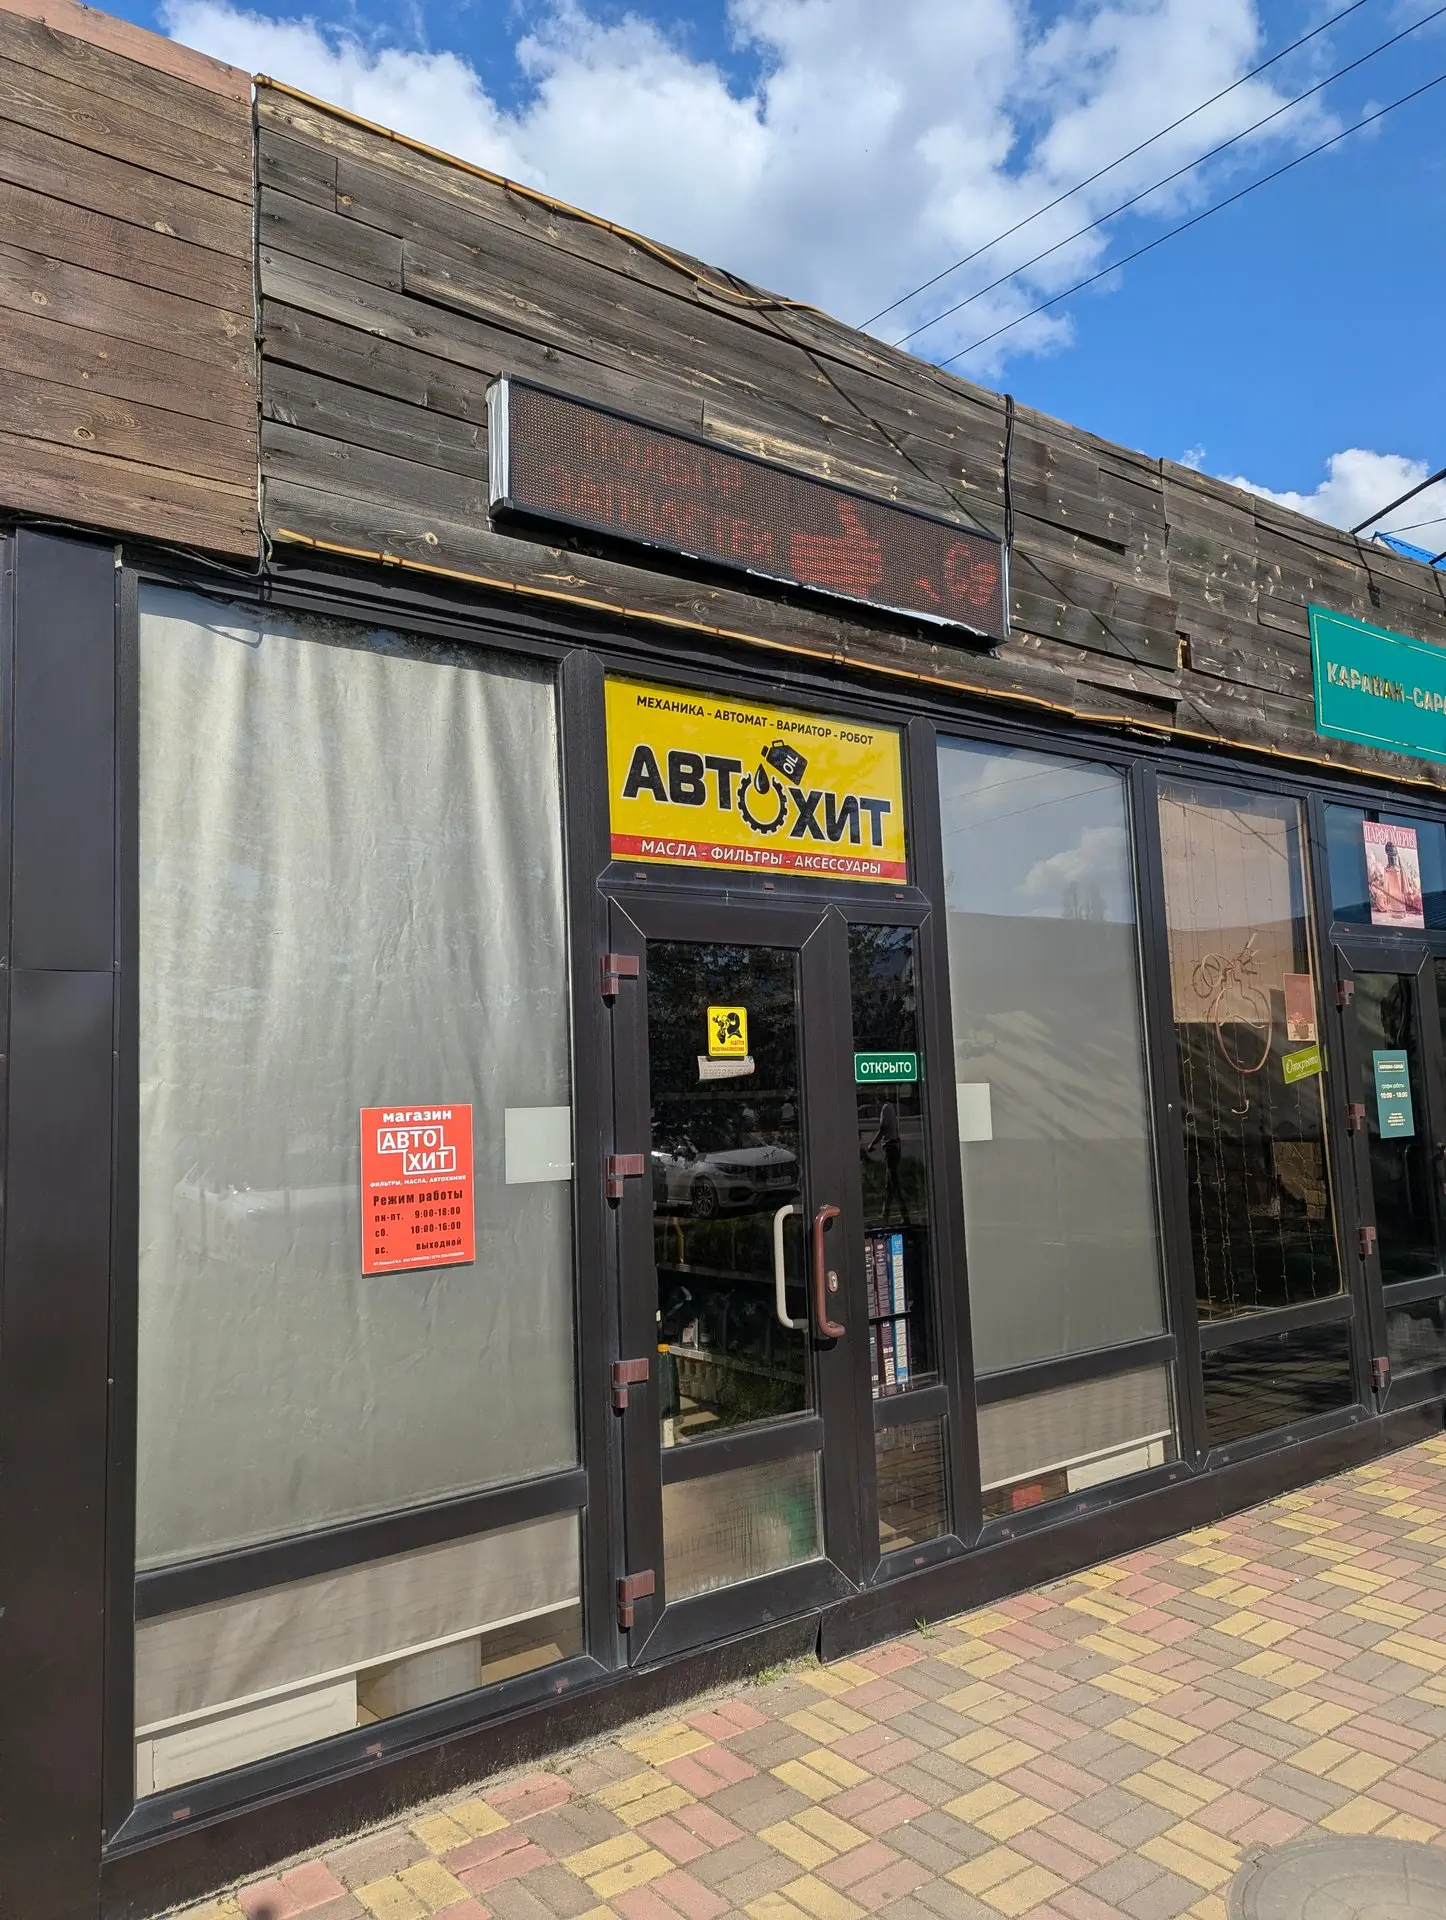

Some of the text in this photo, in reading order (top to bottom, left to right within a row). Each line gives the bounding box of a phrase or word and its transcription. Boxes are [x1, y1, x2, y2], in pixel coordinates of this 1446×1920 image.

[1326, 661, 1446, 715] КАРАВАН-САР
[636, 695, 704, 717] МЕХАНИКА
[714, 710, 768, 728] АВТОМАТ
[776, 720, 832, 738] ВАРИАТОР
[840, 731, 873, 746] РОБОТ
[783, 755, 799, 775] OIL
[1364, 826, 1416, 848] ПАРФЮМЕРИЯ
[641, 839, 698, 858] МАСЛА
[711, 846, 783, 865] ФИЛЬТРЫ
[794, 856, 881, 874] АКСЕССУАРЫ
[860, 1061, 912, 1074] ОТКРЫТО
[383, 1110, 452, 1123] магазин
[381, 1130, 437, 1150] АВТО
[408, 1151, 449, 1171] ХИТ
[373, 1188, 463, 1206] Режим работы
[374, 1206, 461, 1222] пн-пт. 9:00-18:00
[375, 1228, 389, 1238] сб.
[375, 1237, 462, 1255] вс. выходной
